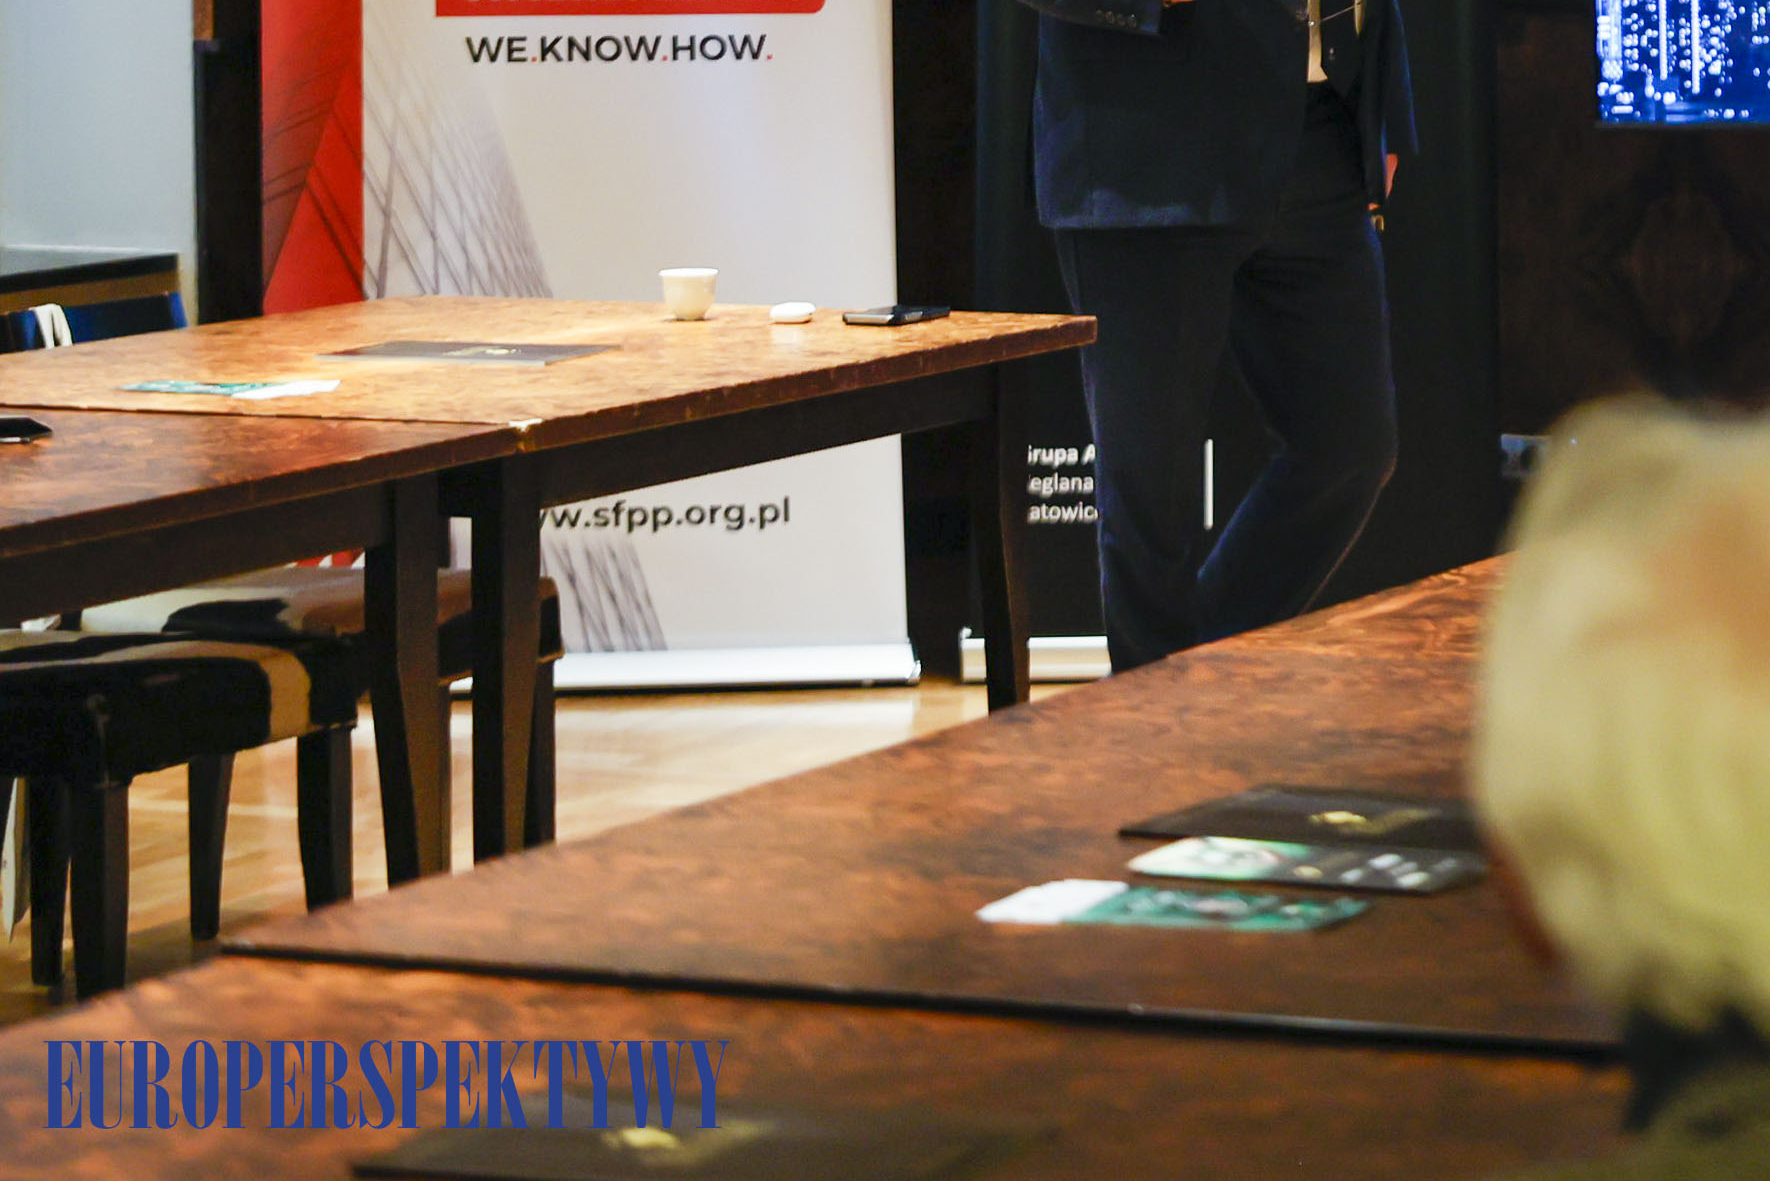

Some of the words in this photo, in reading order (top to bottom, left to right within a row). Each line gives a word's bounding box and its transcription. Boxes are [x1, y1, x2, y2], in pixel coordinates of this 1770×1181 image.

[465, 33, 774, 63] WE.KNOW.HOW.
[1027, 444, 1079, 470] rupa
[1027, 471, 1095, 499] eglana
[539, 495, 791, 534] w.sfpp.org.pl
[1027, 501, 1099, 524] atowic
